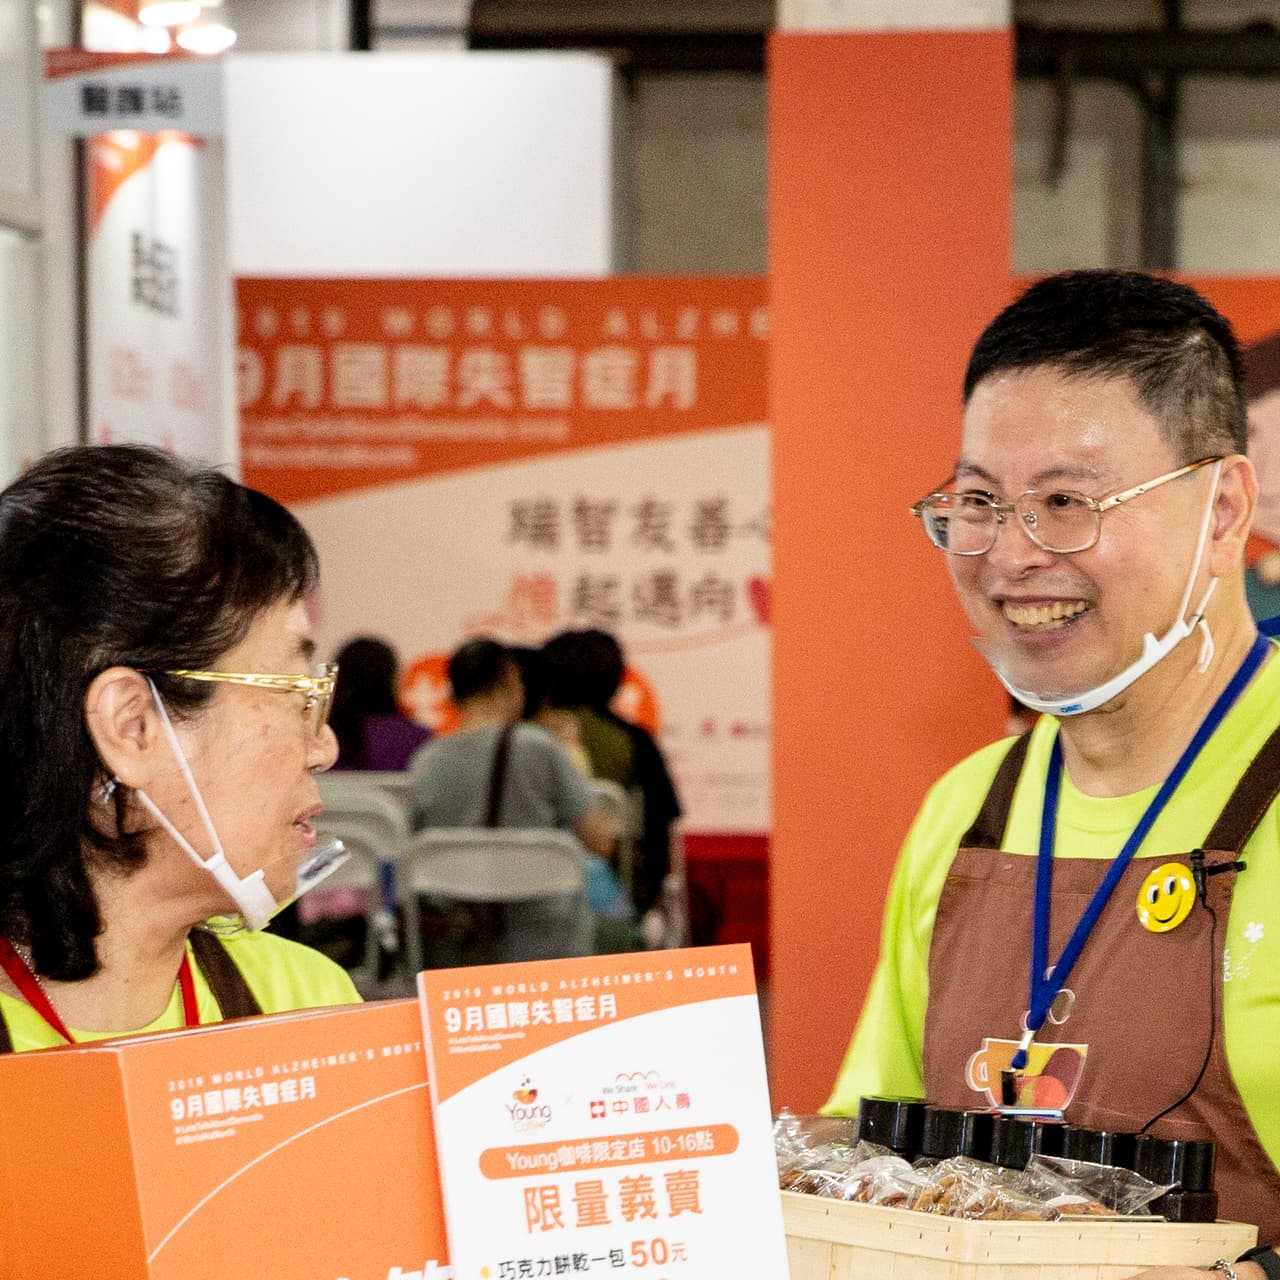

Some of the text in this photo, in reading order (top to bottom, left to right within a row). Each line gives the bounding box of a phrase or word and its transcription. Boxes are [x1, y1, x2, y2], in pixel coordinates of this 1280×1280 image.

[492, 980, 549, 996] WORLD
[559, 970, 674, 990] ALZHEIMER'S
[683, 964, 738, 979] MONTH
[444, 993, 618, 1033] 9月國際失智症月
[211, 1066, 265, 1085] WORLD
[271, 1048, 375, 1074] ALZHEIMER'S
[382, 1041, 422, 1057] MONT
[169, 1075, 317, 1121] 9月國際失智症月
[506, 1102, 552, 1123] Young
[613, 1092, 691, 1115] 中國人壽
[505, 1126, 715, 1171] Young咖啡限定店 10-16點
[523, 1168, 703, 1234] 限量義賣
